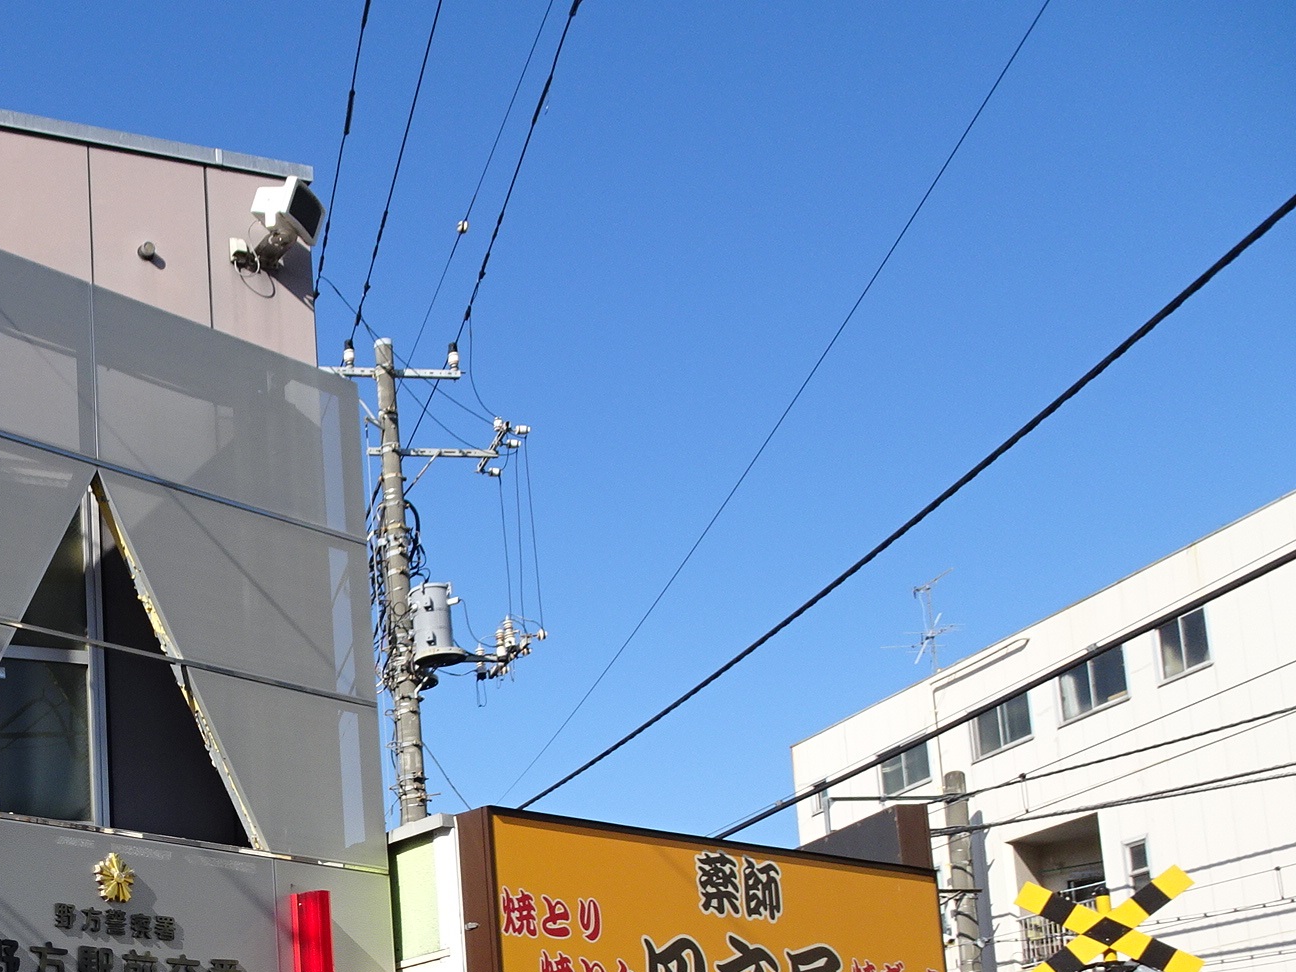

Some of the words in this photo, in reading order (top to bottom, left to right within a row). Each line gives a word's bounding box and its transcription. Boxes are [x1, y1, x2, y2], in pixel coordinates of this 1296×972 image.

[696, 851, 782, 922] 薬師
[54, 903, 176, 941] 野方警察署
[502, 887, 602, 942] 焼とり
